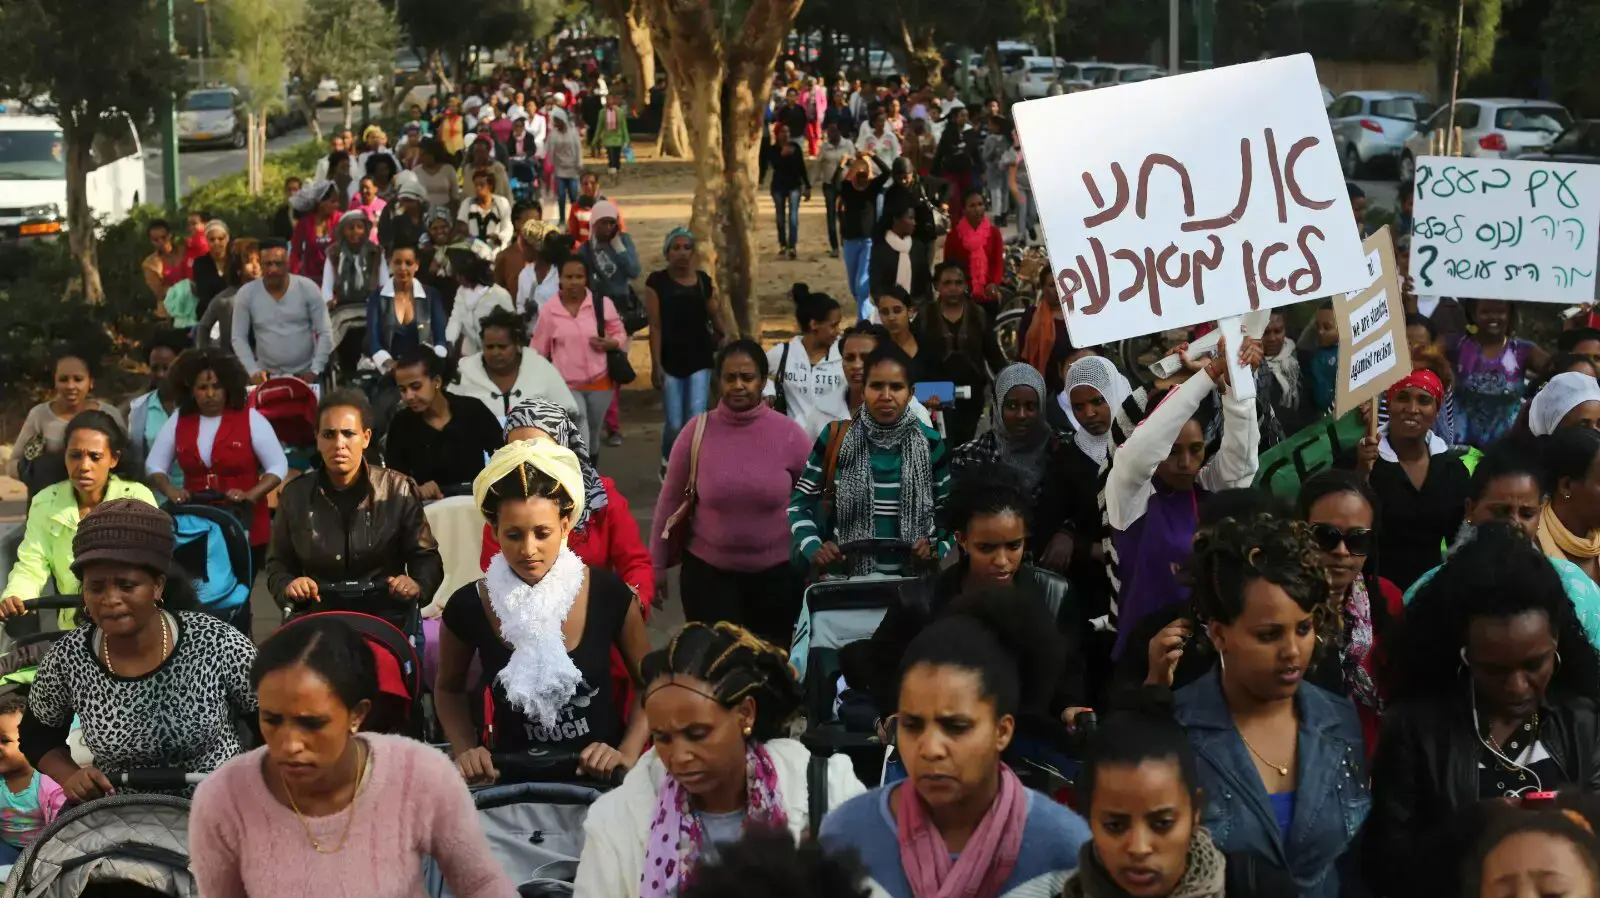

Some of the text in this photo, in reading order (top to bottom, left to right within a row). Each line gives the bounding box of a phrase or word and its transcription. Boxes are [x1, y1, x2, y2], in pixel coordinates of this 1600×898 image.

[1524, 169, 1580, 208] עם
[1475, 216, 1523, 250] נכנס
[1531, 214, 1585, 250] היה
[1242, 225, 1325, 310] לא
[1551, 265, 1592, 288] מה
[1352, 321, 1360, 338] we
[1361, 315, 1370, 332] are
[523, 716, 590, 742] TOUCH
